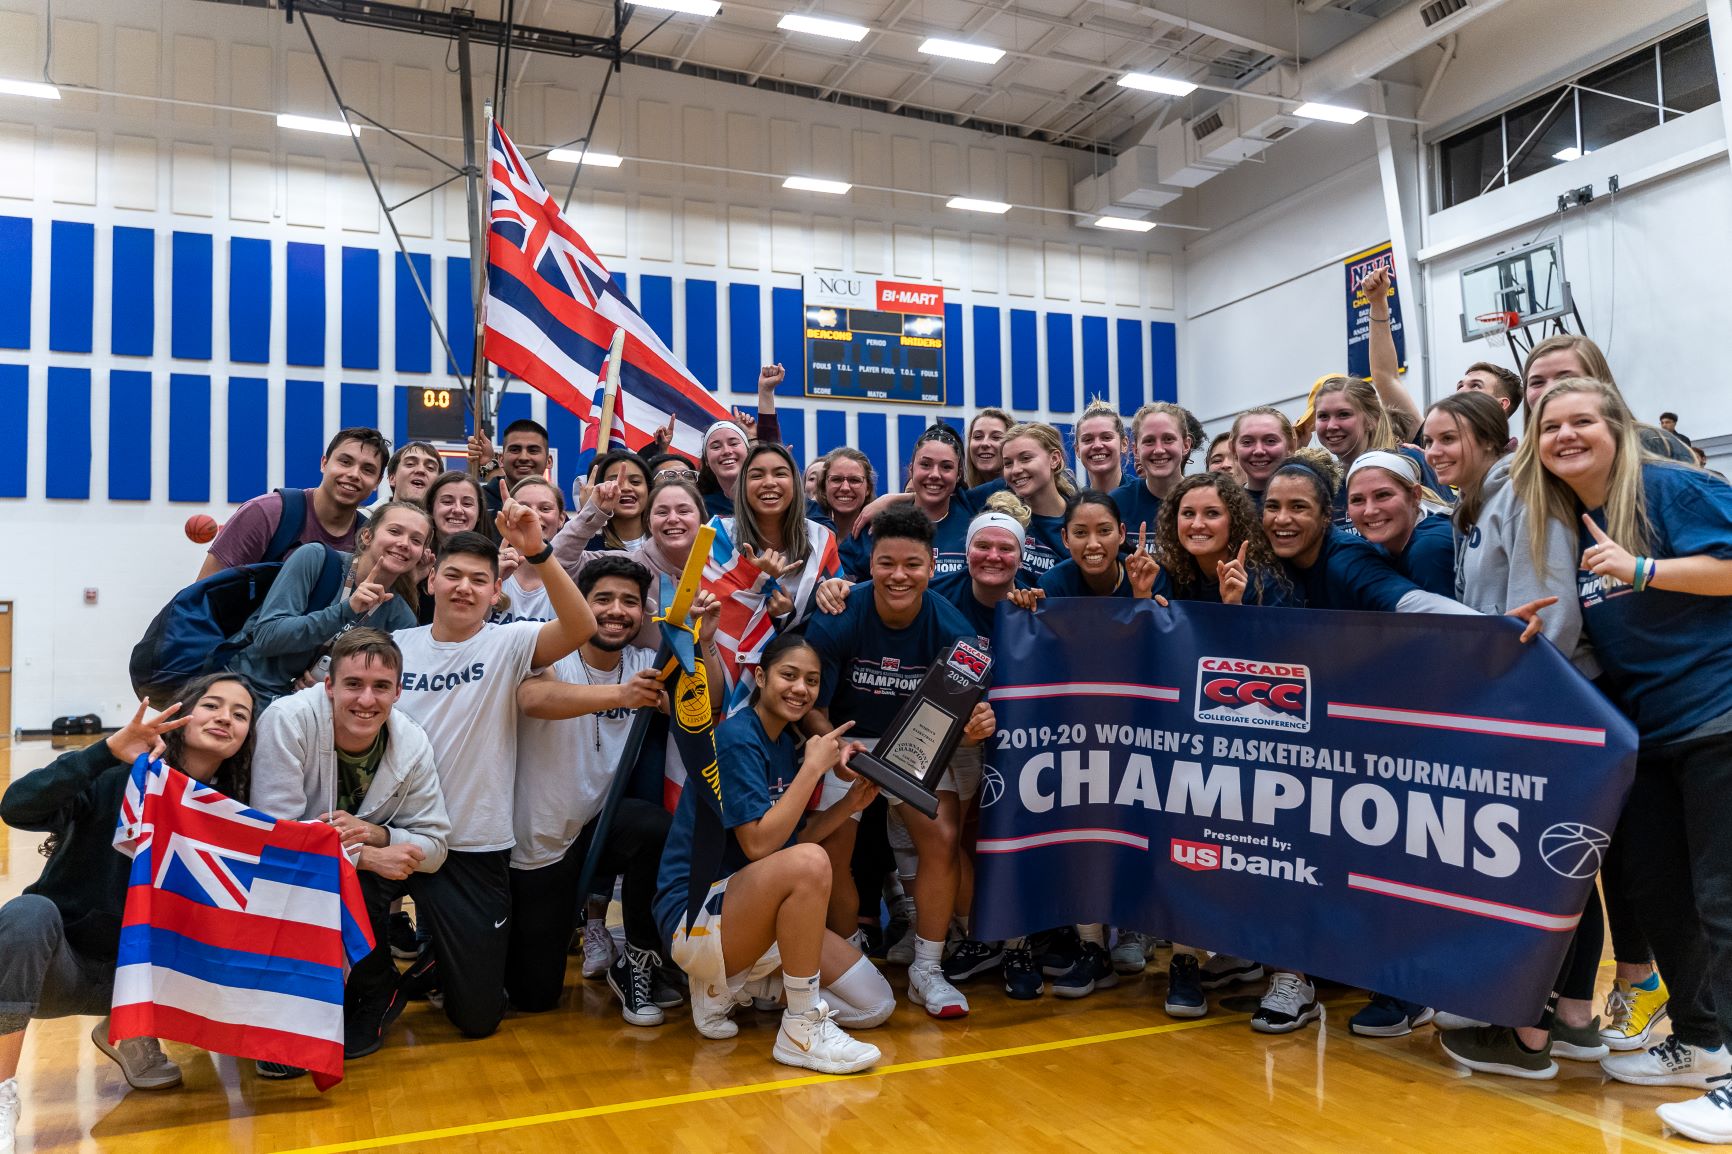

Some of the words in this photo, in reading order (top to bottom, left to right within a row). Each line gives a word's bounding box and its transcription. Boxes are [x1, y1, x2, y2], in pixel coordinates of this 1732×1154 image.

[819, 277, 861, 296] NCU
[806, 328, 853, 342] BEACONS
[866, 338, 887, 347] PERIOD
[900, 335, 943, 349] RAIDERS
[812, 362, 832, 370] FOULS
[858, 365, 880, 373] PLAYER
[880, 367, 895, 375] FOUL
[920, 370, 939, 378] FOULS
[423, 390, 450, 408] 0.0
[813, 387, 832, 395] SCORE
[867, 390, 888, 398] MATCH
[921, 394, 939, 402] SCORE
[959, 642, 990, 663] CASCADE
[402, 662, 485, 691] EACONS
[1202, 659, 1305, 678] CASCADE
[852, 671, 922, 691] CHAMPION
[947, 670, 969, 687] 2020
[1203, 678, 1305, 711] CCC
[1198, 712, 1250, 724] COLLEGIATE
[1251, 718, 1307, 730] CONFERENCE
[996, 723, 1087, 750] 2019-20
[1094, 723, 1204, 755] WOMEN'S
[1212, 736, 1356, 774] BASKETBALL
[1363, 753, 1548, 801] TOURNAMENT
[1018, 750, 1521, 878] CHAMPIONS
[1203, 828, 1269, 847] Presented
[1272, 837, 1292, 851] by:
